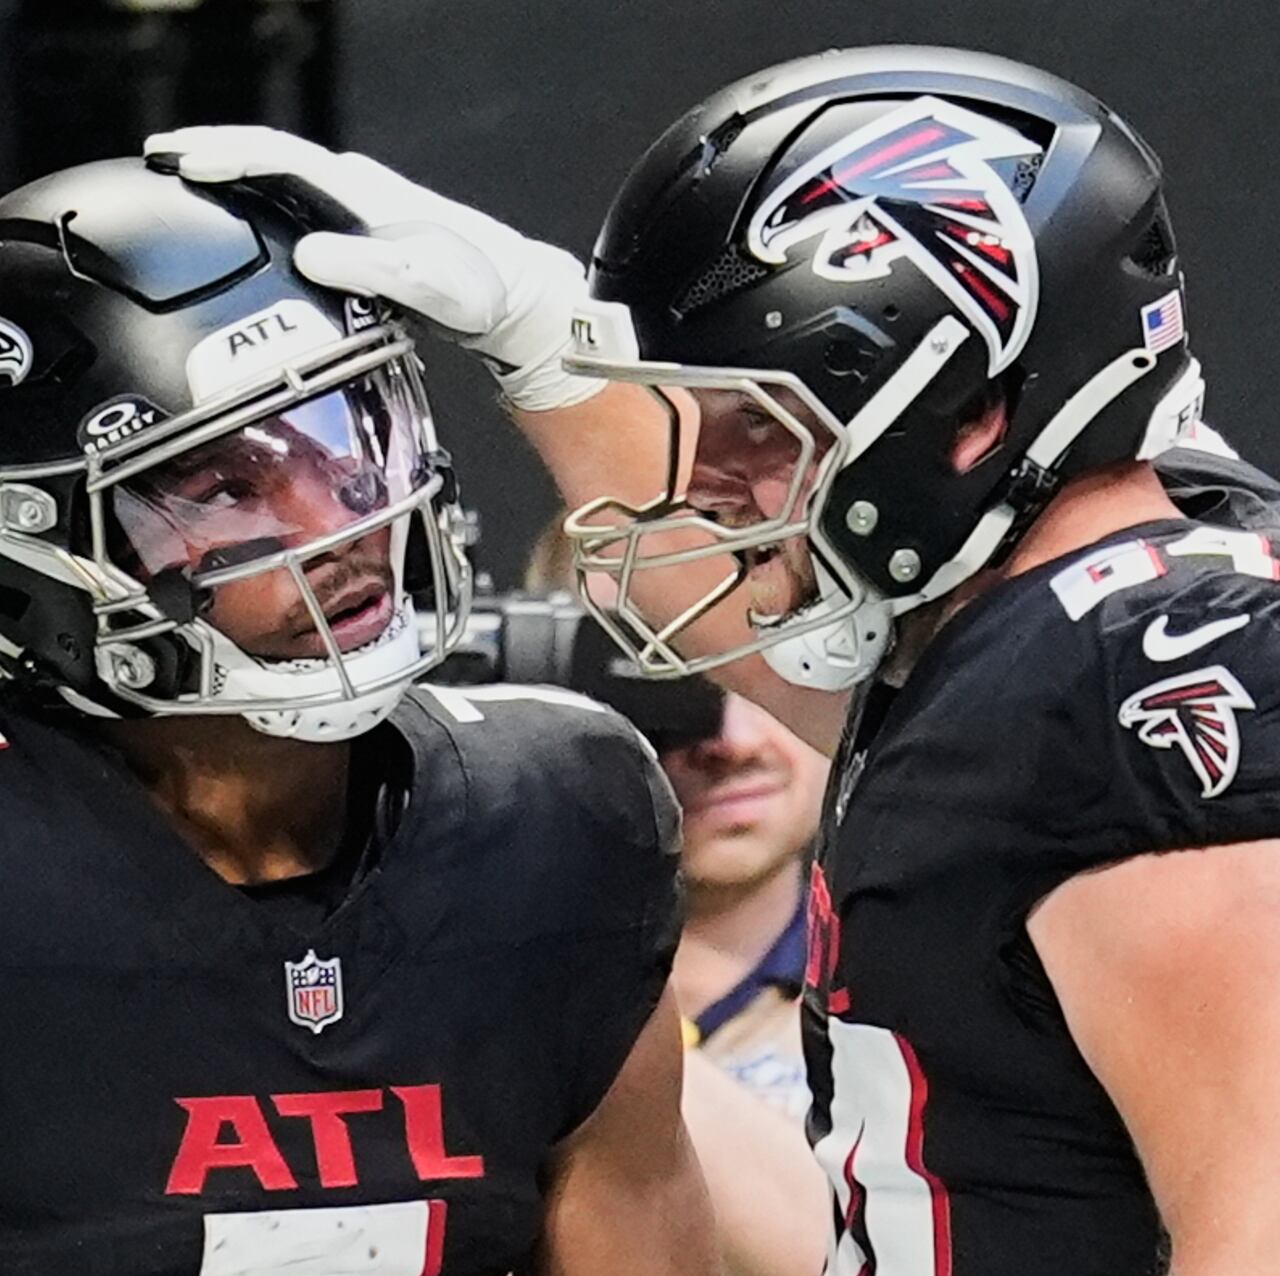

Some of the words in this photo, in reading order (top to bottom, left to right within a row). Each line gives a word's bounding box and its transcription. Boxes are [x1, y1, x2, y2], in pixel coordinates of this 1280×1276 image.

[228, 314, 297, 356] ATL
[298, 988, 336, 1018] NFL
[164, 1084, 484, 1194] ATL
